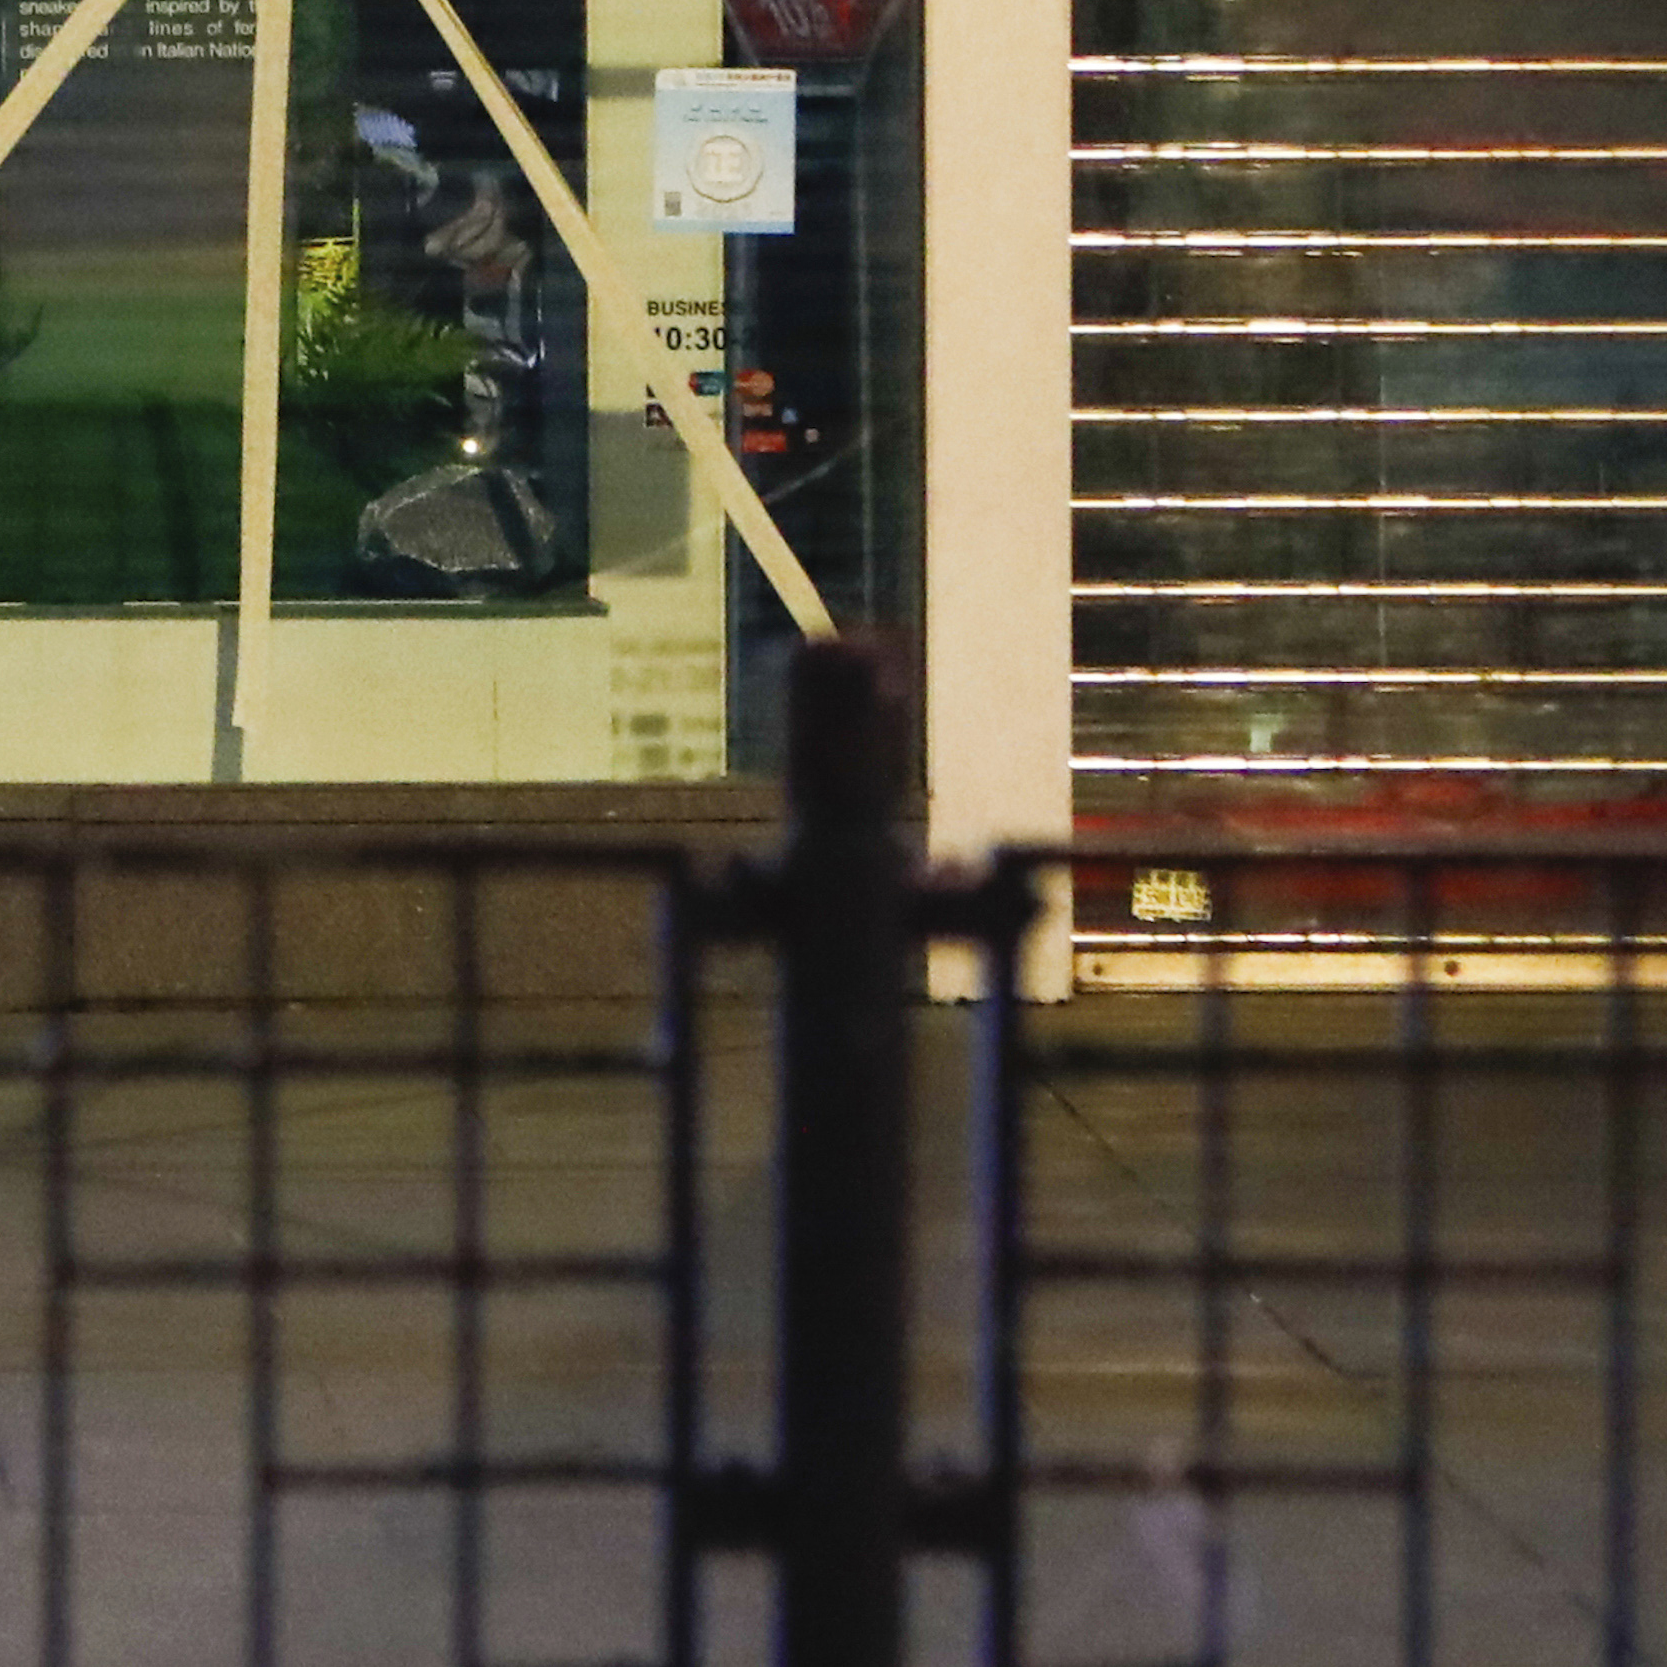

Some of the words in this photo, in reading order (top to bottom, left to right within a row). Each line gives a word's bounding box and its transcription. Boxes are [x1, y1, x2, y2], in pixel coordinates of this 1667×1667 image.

[207, 21, 224, 36] of
[157, 43, 204, 58] Italian
[647, 300, 726, 317] BUSINE
[653, 326, 728, 351] 0:30
